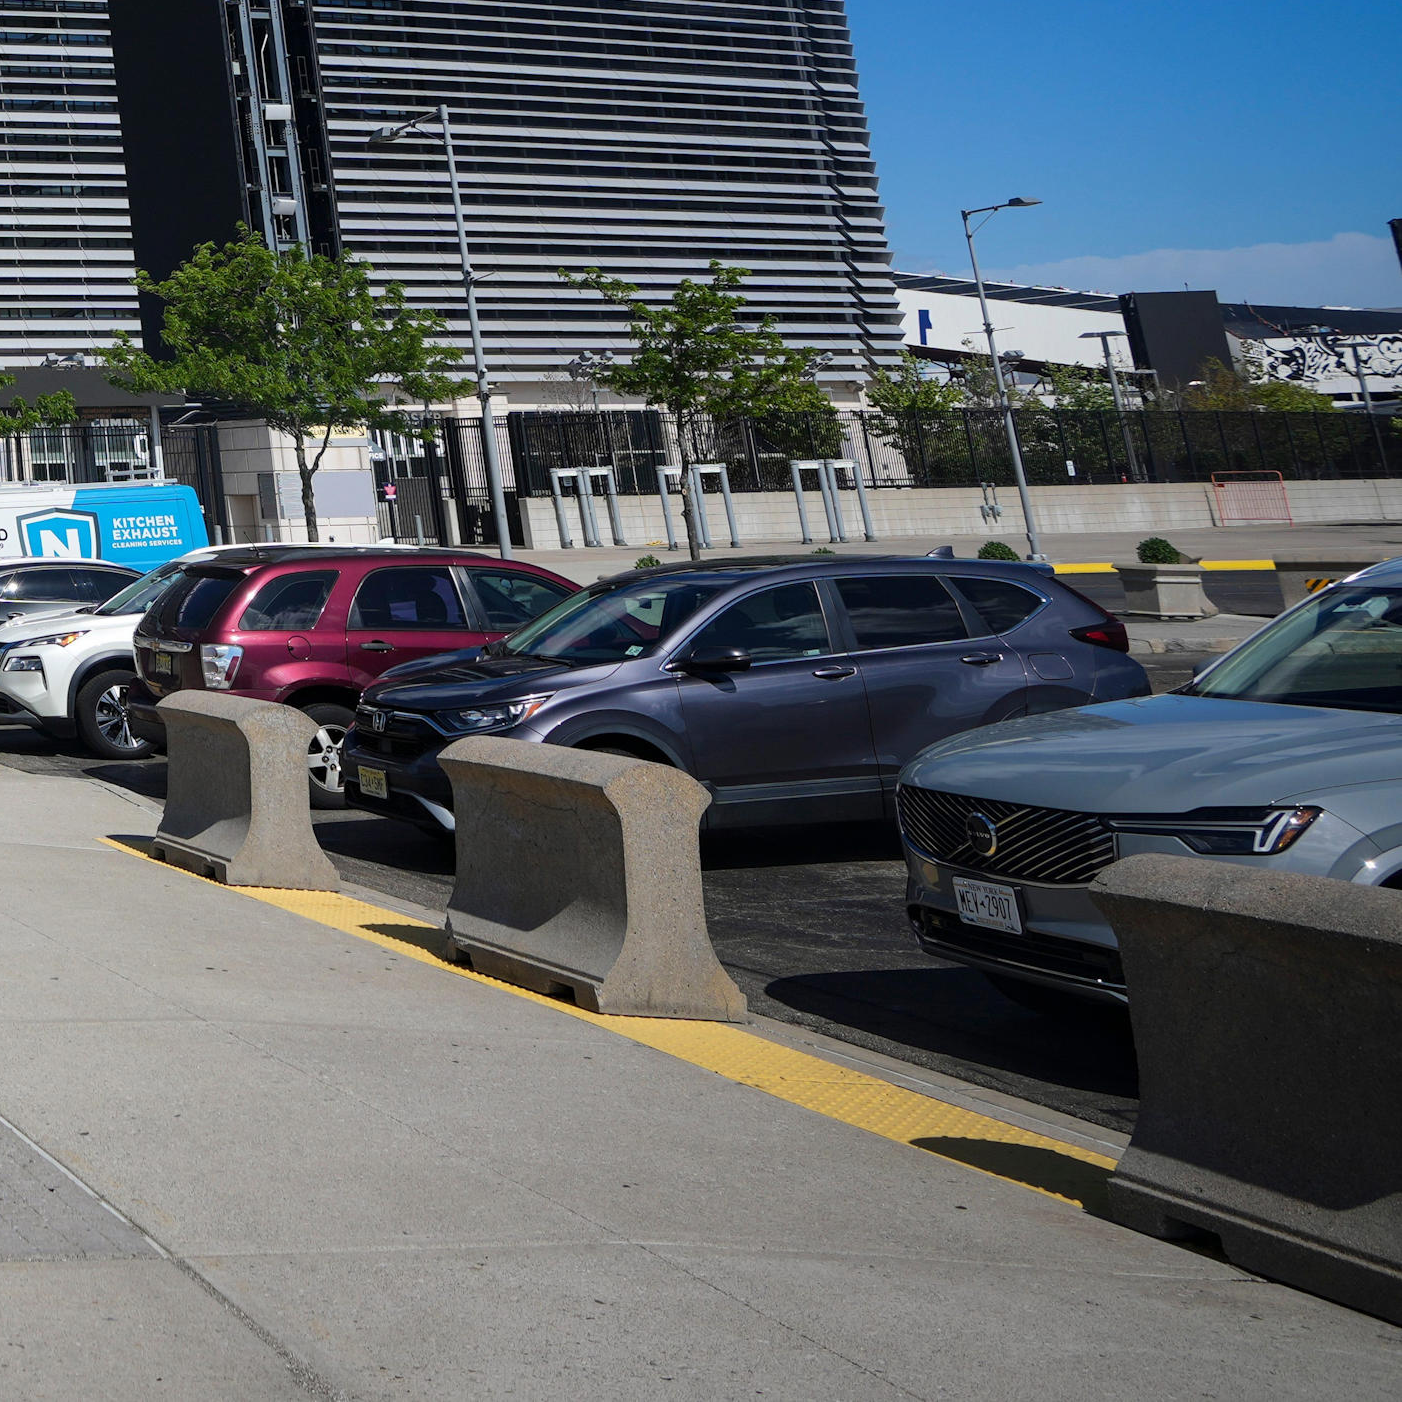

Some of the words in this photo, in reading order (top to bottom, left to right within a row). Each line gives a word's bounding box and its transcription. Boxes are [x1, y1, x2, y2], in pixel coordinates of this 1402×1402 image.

[112, 515, 175, 529] KITCHEN
[112, 526, 179, 541] EXHAUST
[112, 540, 147, 549] CLEANING
[148, 539, 183, 548] SERVICES
[968, 883, 981, 892] NEW
[982, 885, 998, 895] YORK
[985, 894, 1012, 921] 2907
